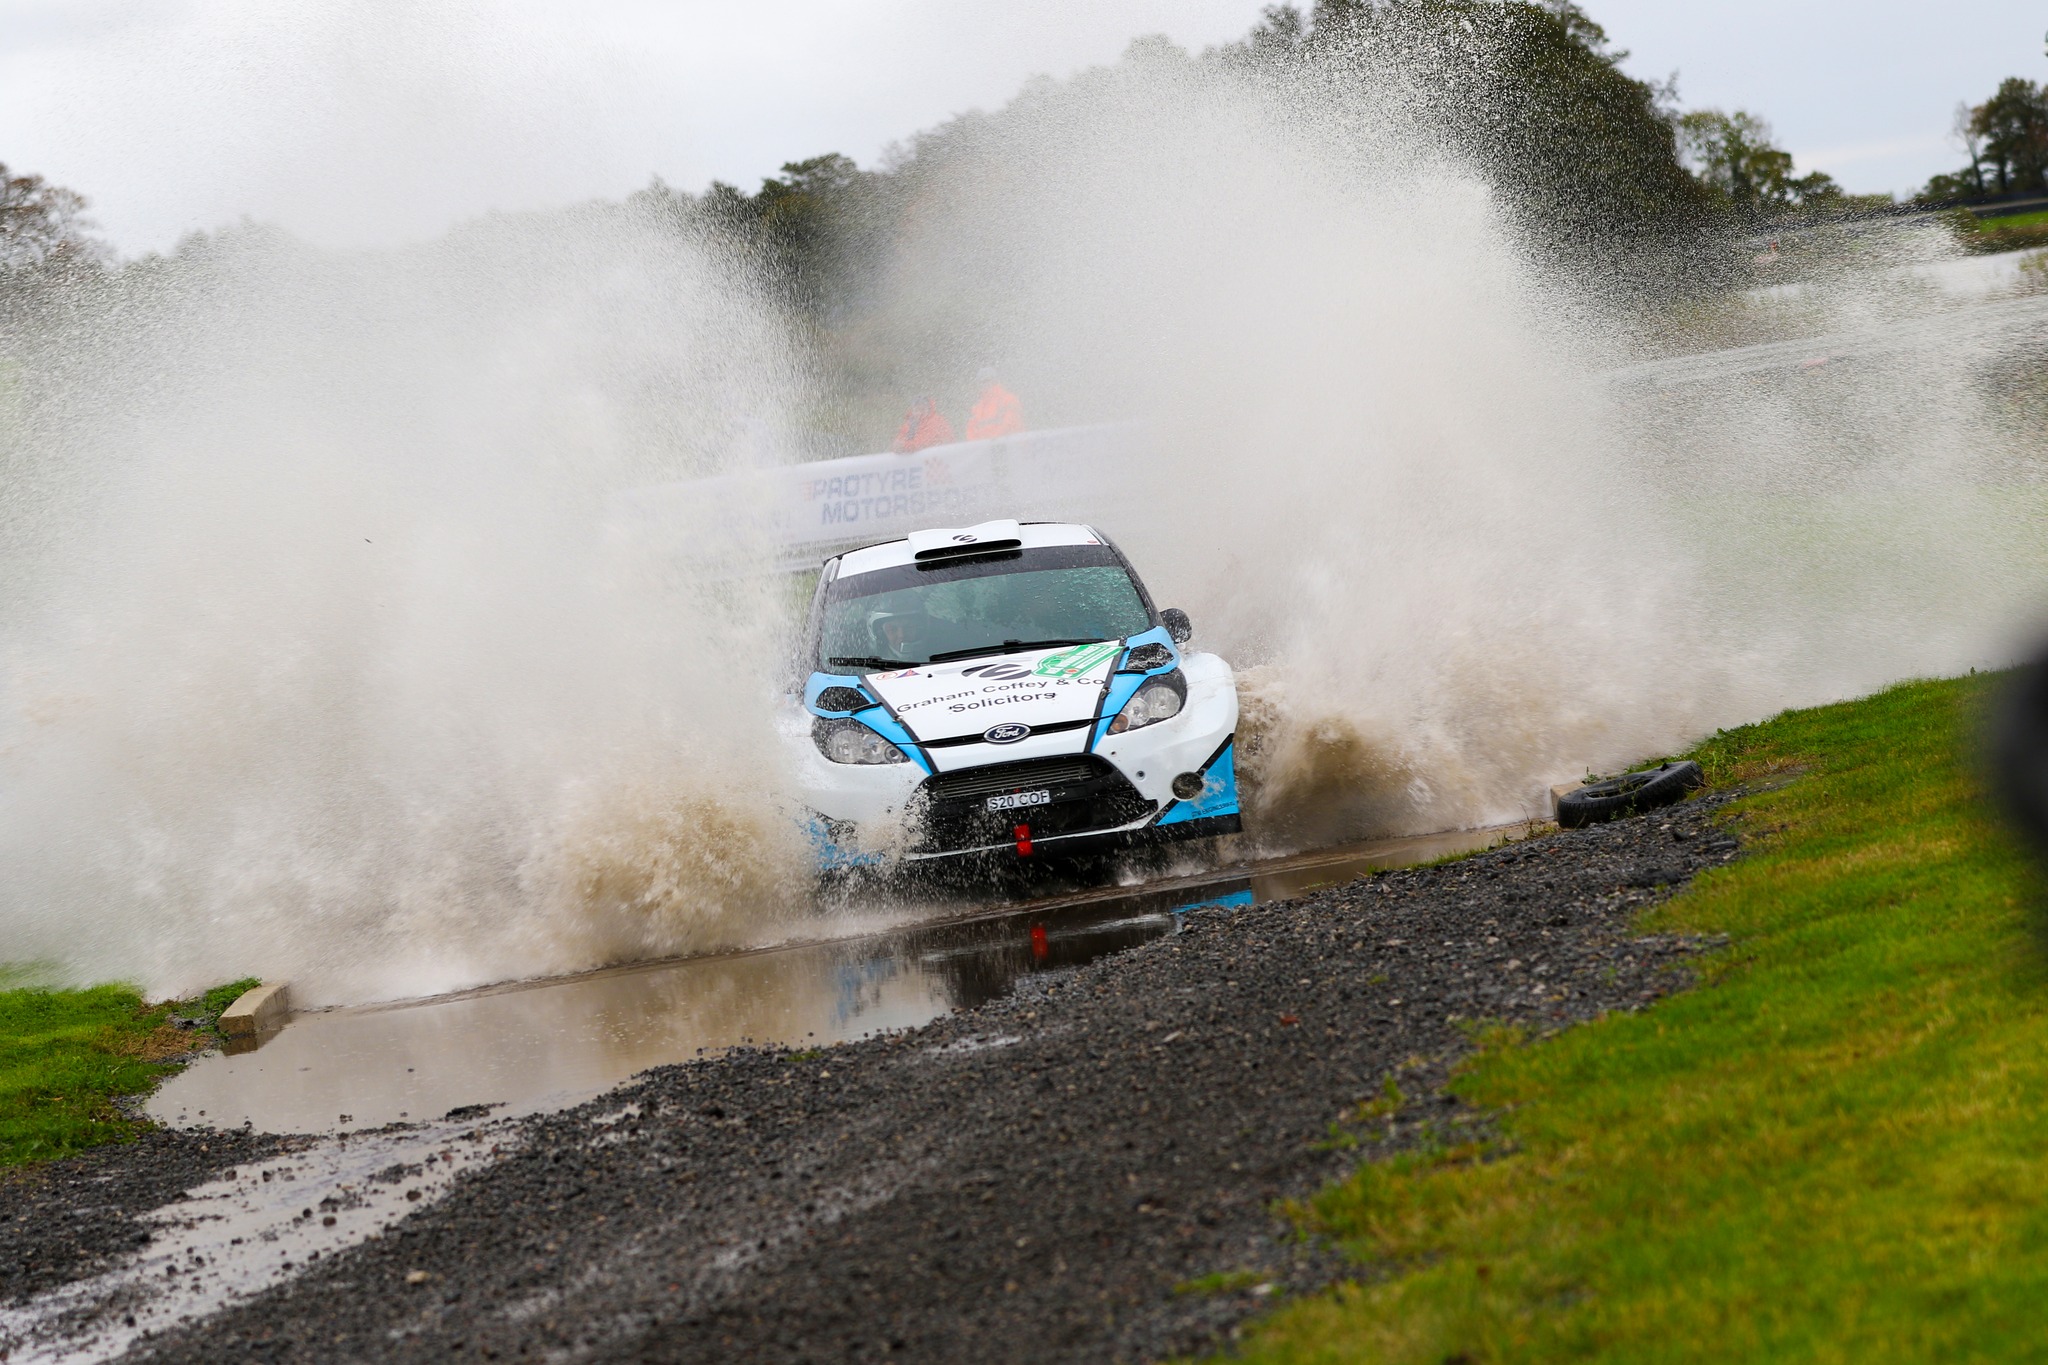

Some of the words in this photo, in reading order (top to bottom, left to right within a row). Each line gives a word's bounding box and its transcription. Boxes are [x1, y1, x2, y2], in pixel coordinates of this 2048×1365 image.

[812, 467, 923, 499] PROTYRE
[897, 690, 976, 713] Graham
[982, 681, 1048, 693] Coffey
[951, 691, 1055, 713] Solicitors
[994, 726, 1020, 739] Ford
[989, 796, 1014, 810] S20
[1019, 791, 1048, 806] COF
